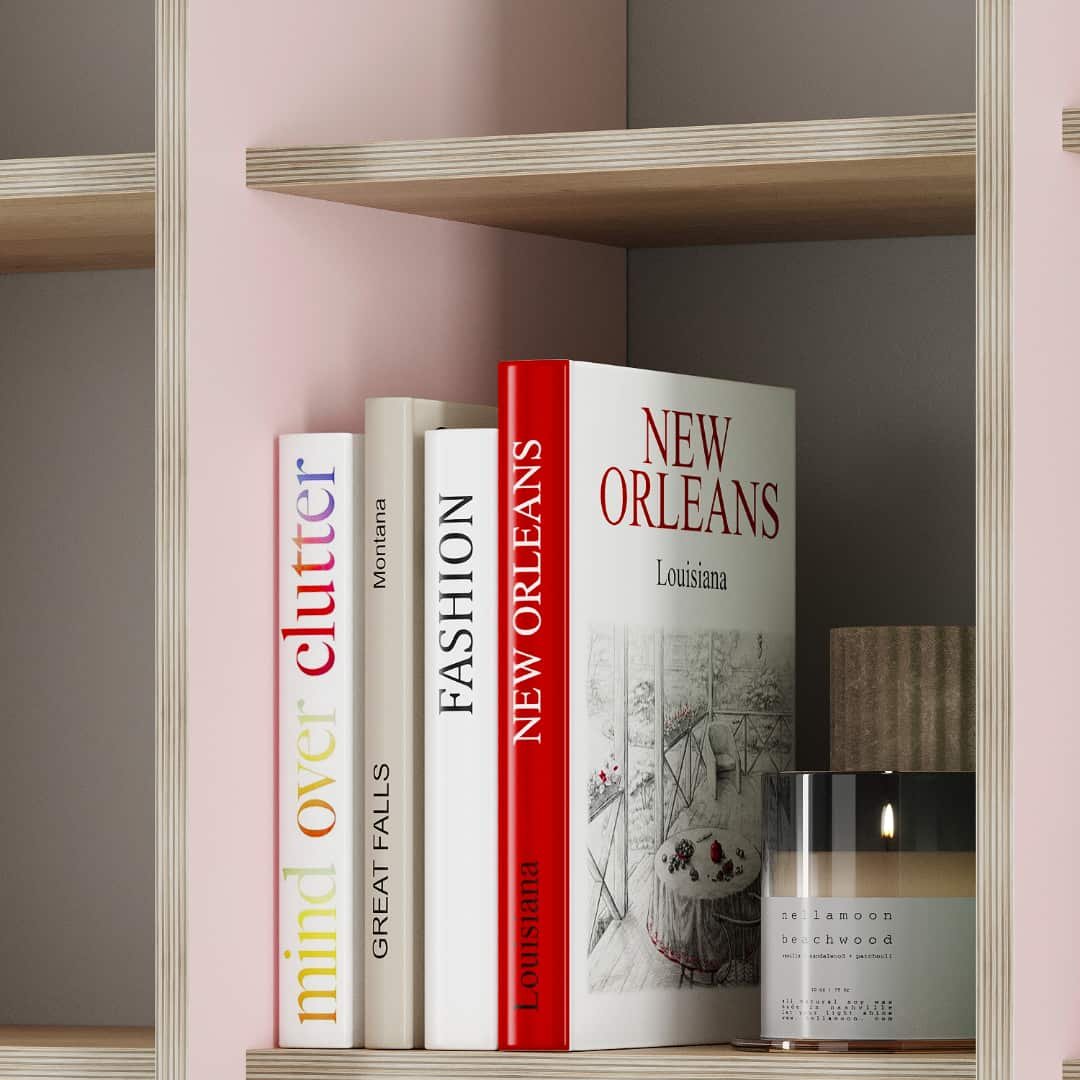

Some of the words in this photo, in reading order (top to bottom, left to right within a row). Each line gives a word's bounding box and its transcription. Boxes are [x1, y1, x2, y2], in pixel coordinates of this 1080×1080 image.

[641, 407, 733, 472] NEW
[373, 498, 387, 589] Montana
[513, 439, 542, 636] ORLEANS
[600, 466, 780, 540] ORLEANS
[281, 457, 336, 677] clutter
[438, 493, 474, 715] FASHION
[656, 558, 728, 591] Louisiana
[513, 648, 542, 745] NEW
[297, 698, 337, 838] over
[372, 763, 390, 850] FALLS
[282, 864, 337, 1025] mind
[372, 860, 389, 959] GREAT
[514, 860, 539, 1012] Louisiana
